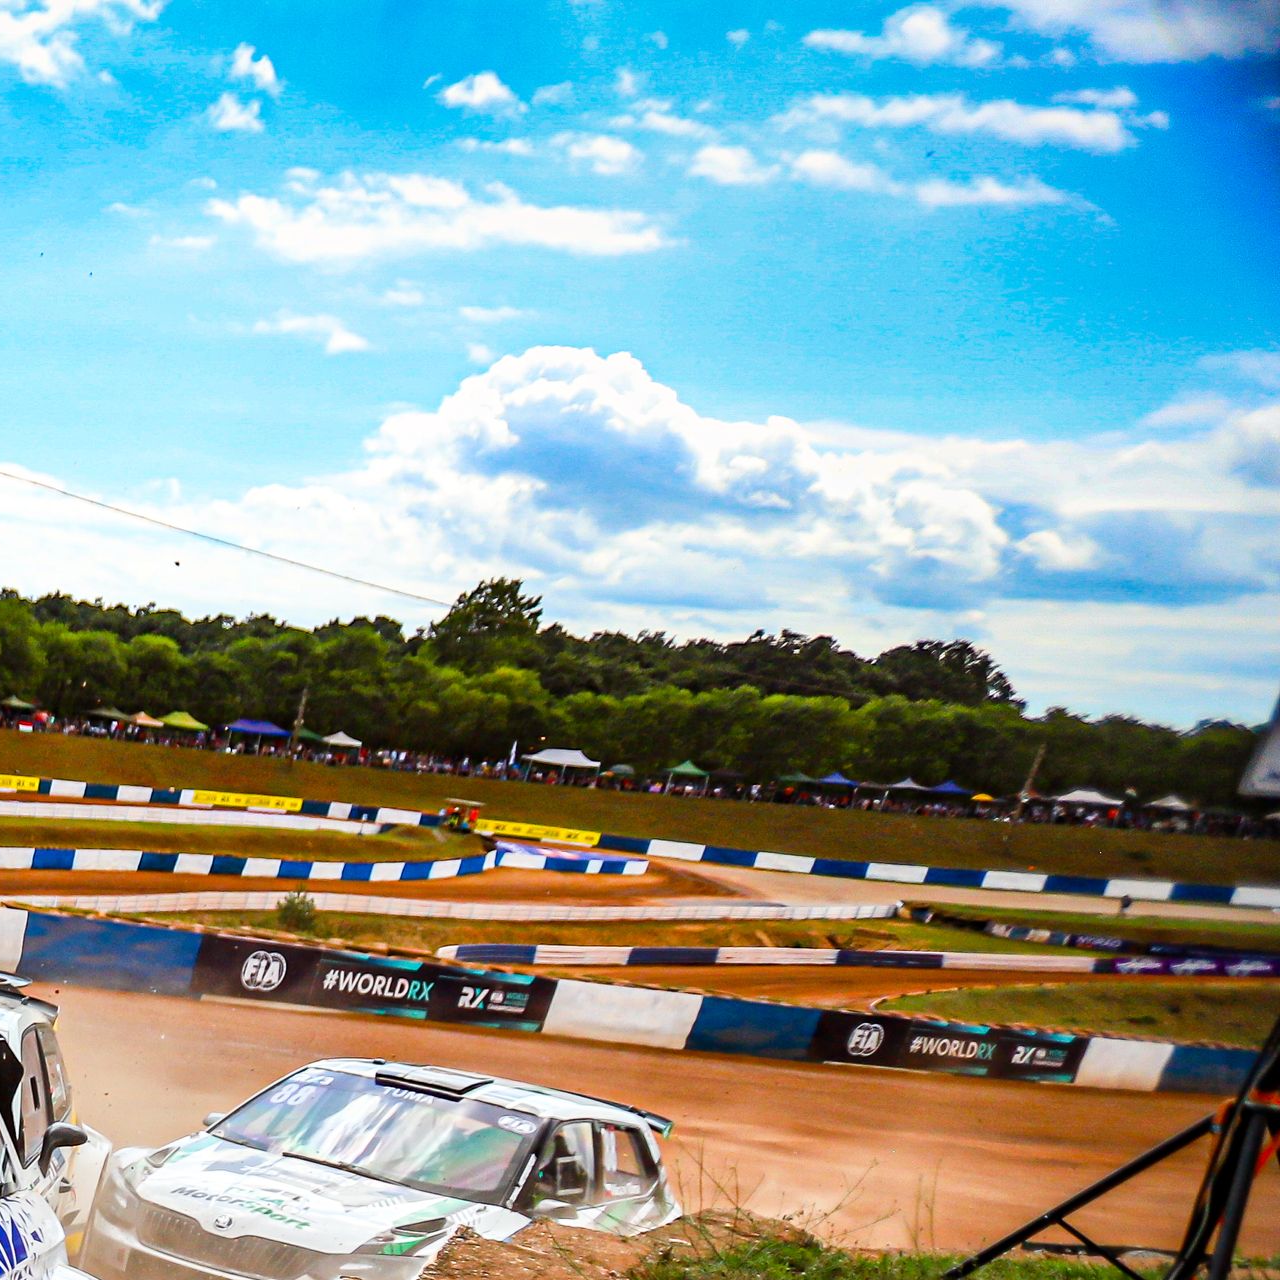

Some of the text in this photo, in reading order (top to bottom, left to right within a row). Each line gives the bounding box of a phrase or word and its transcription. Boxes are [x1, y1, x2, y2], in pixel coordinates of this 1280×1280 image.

[323, 968, 435, 1002] #WORLDRX
[457, 985, 491, 1009] RX
[910, 1035, 997, 1061] #WORLDRX
[384, 1086, 435, 1104] TUMA
[171, 1185, 313, 1231] Motorsport
